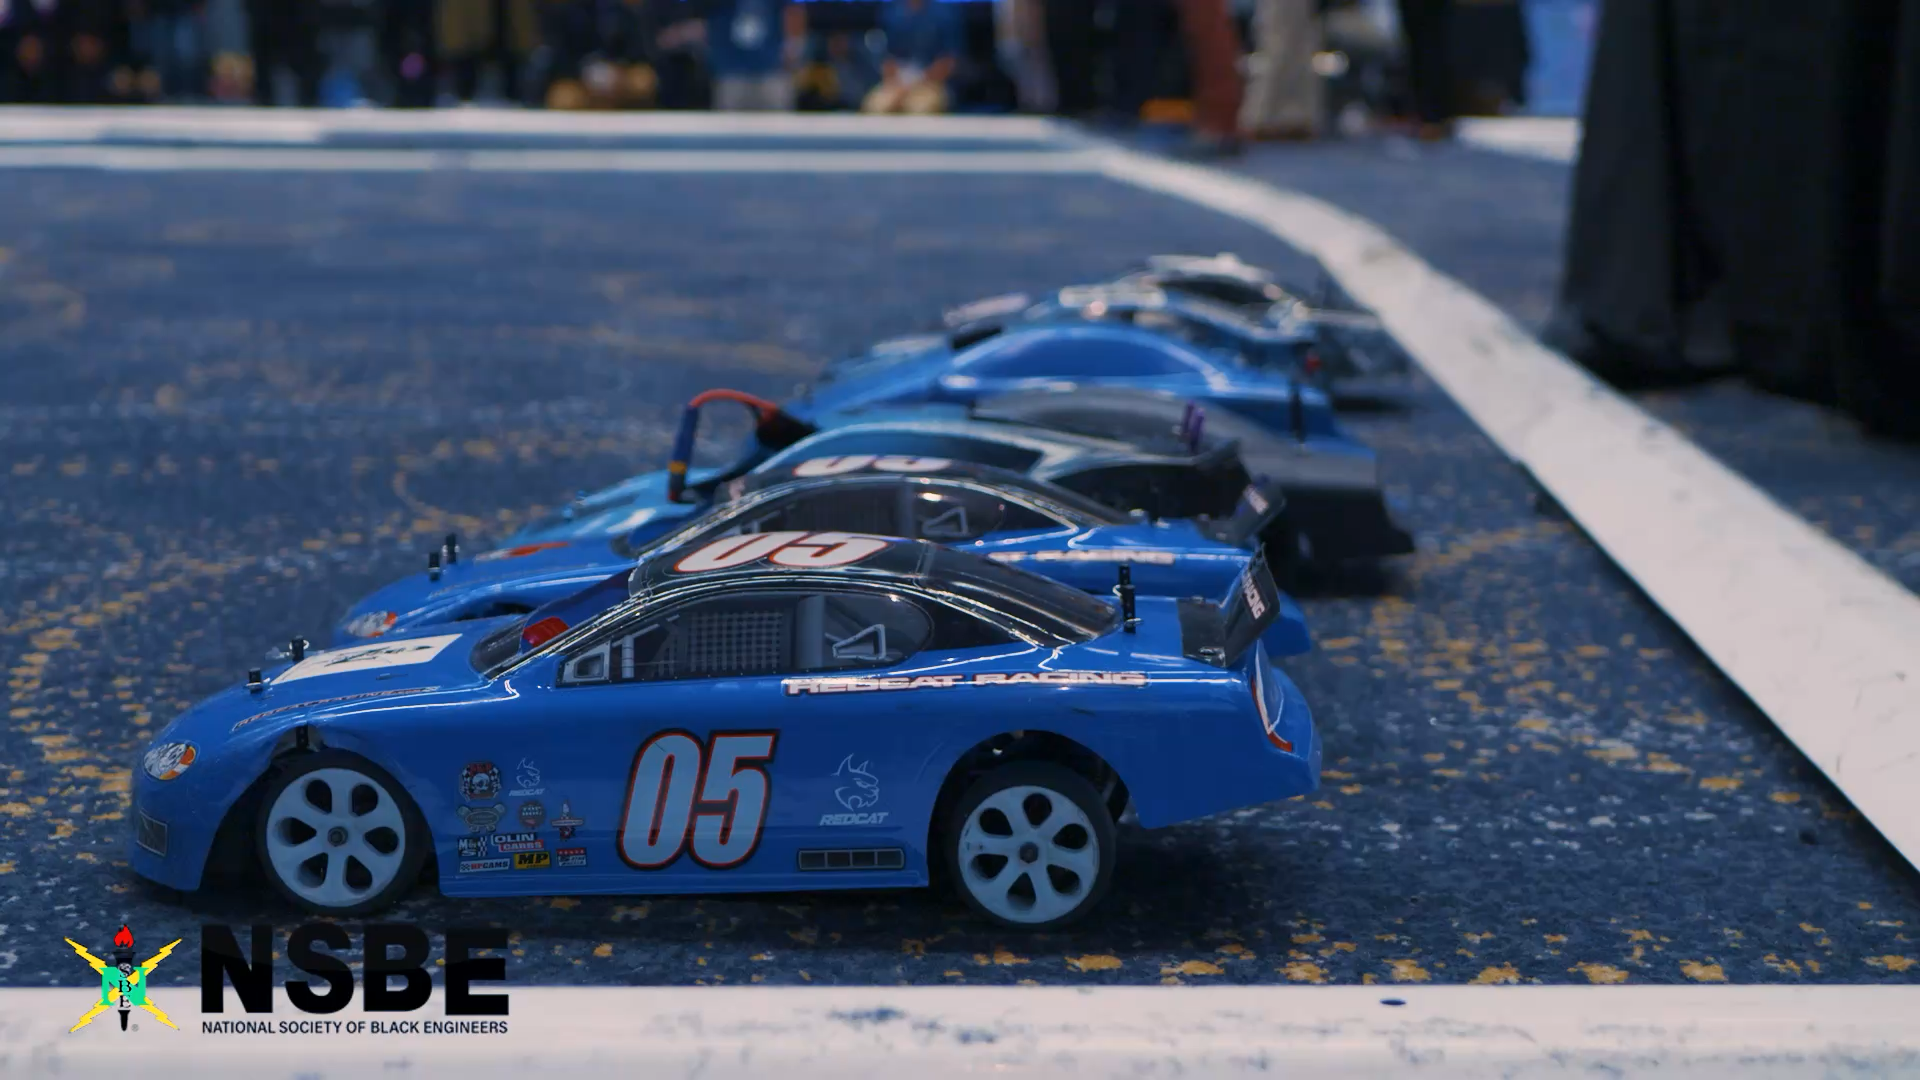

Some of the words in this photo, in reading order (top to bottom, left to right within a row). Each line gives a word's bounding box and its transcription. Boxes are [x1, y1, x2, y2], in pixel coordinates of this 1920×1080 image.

[785, 674, 963, 696] REDCAT
[973, 671, 1148, 688] RACING
[617, 729, 779, 870] 05
[819, 812, 888, 826] REDCAT
[518, 853, 549, 865] MP
